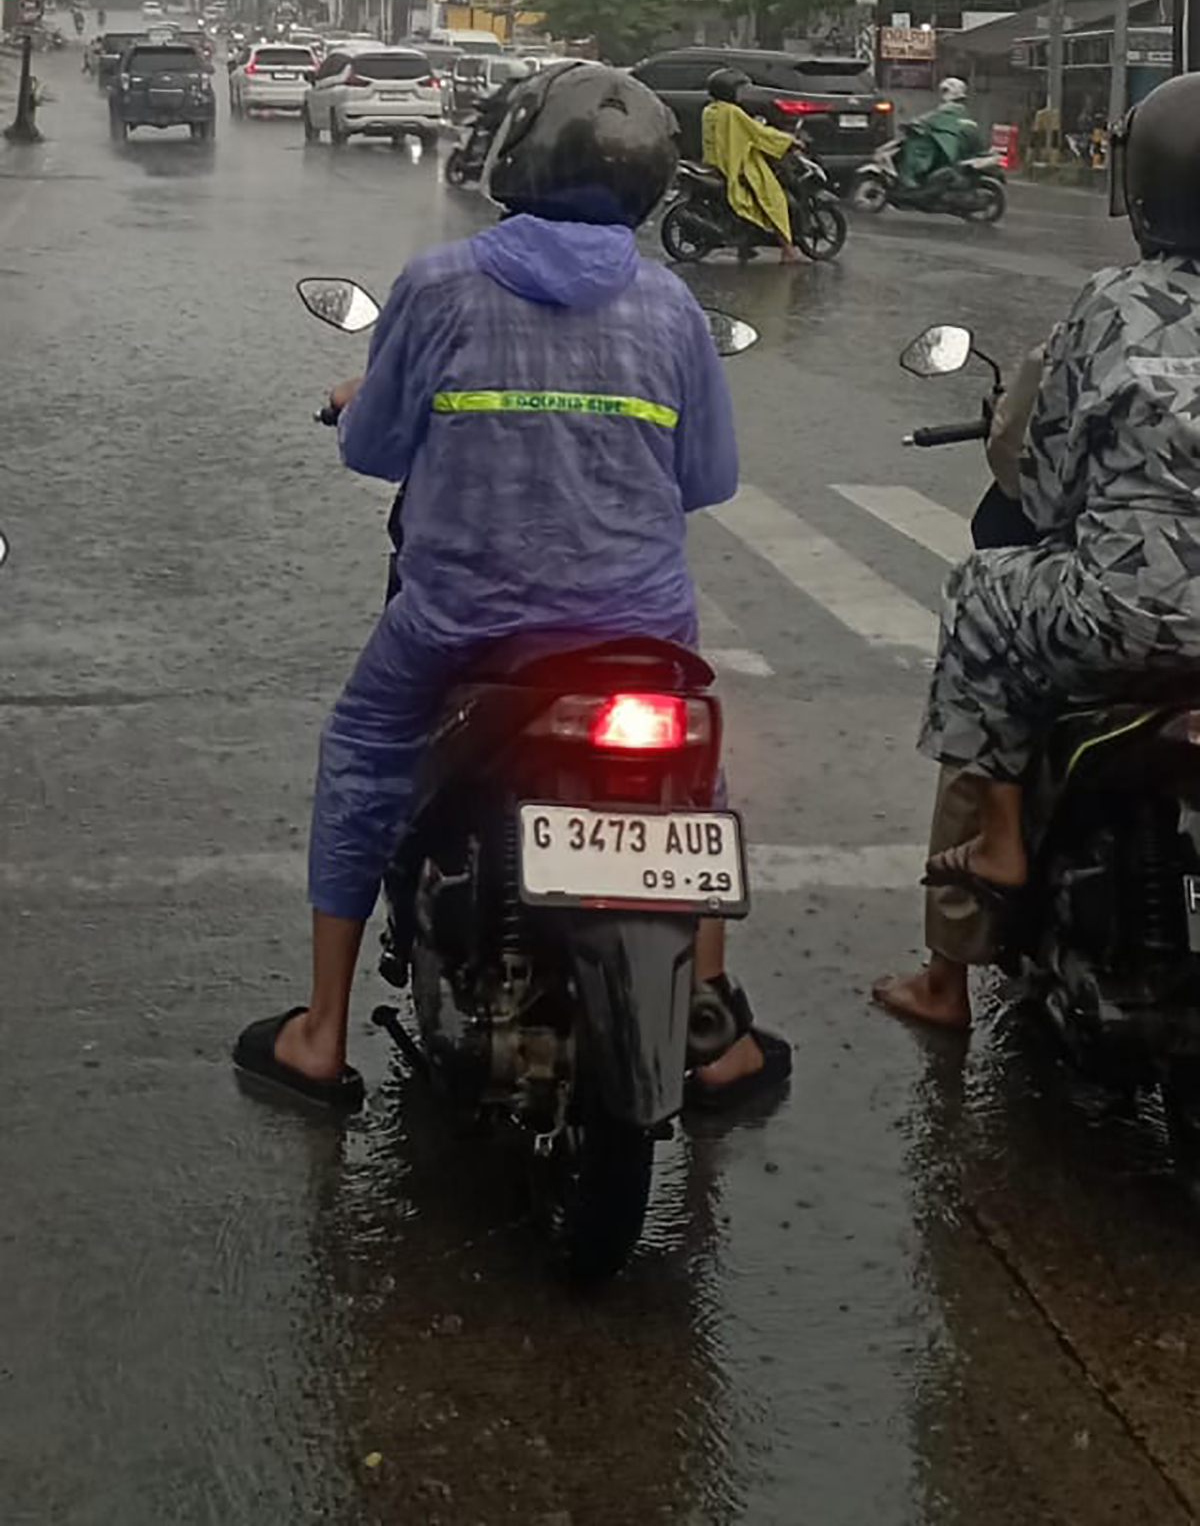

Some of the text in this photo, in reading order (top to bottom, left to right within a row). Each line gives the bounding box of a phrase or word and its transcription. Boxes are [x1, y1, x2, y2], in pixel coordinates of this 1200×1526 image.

[534, 816, 723, 856] G 3473 AUB
